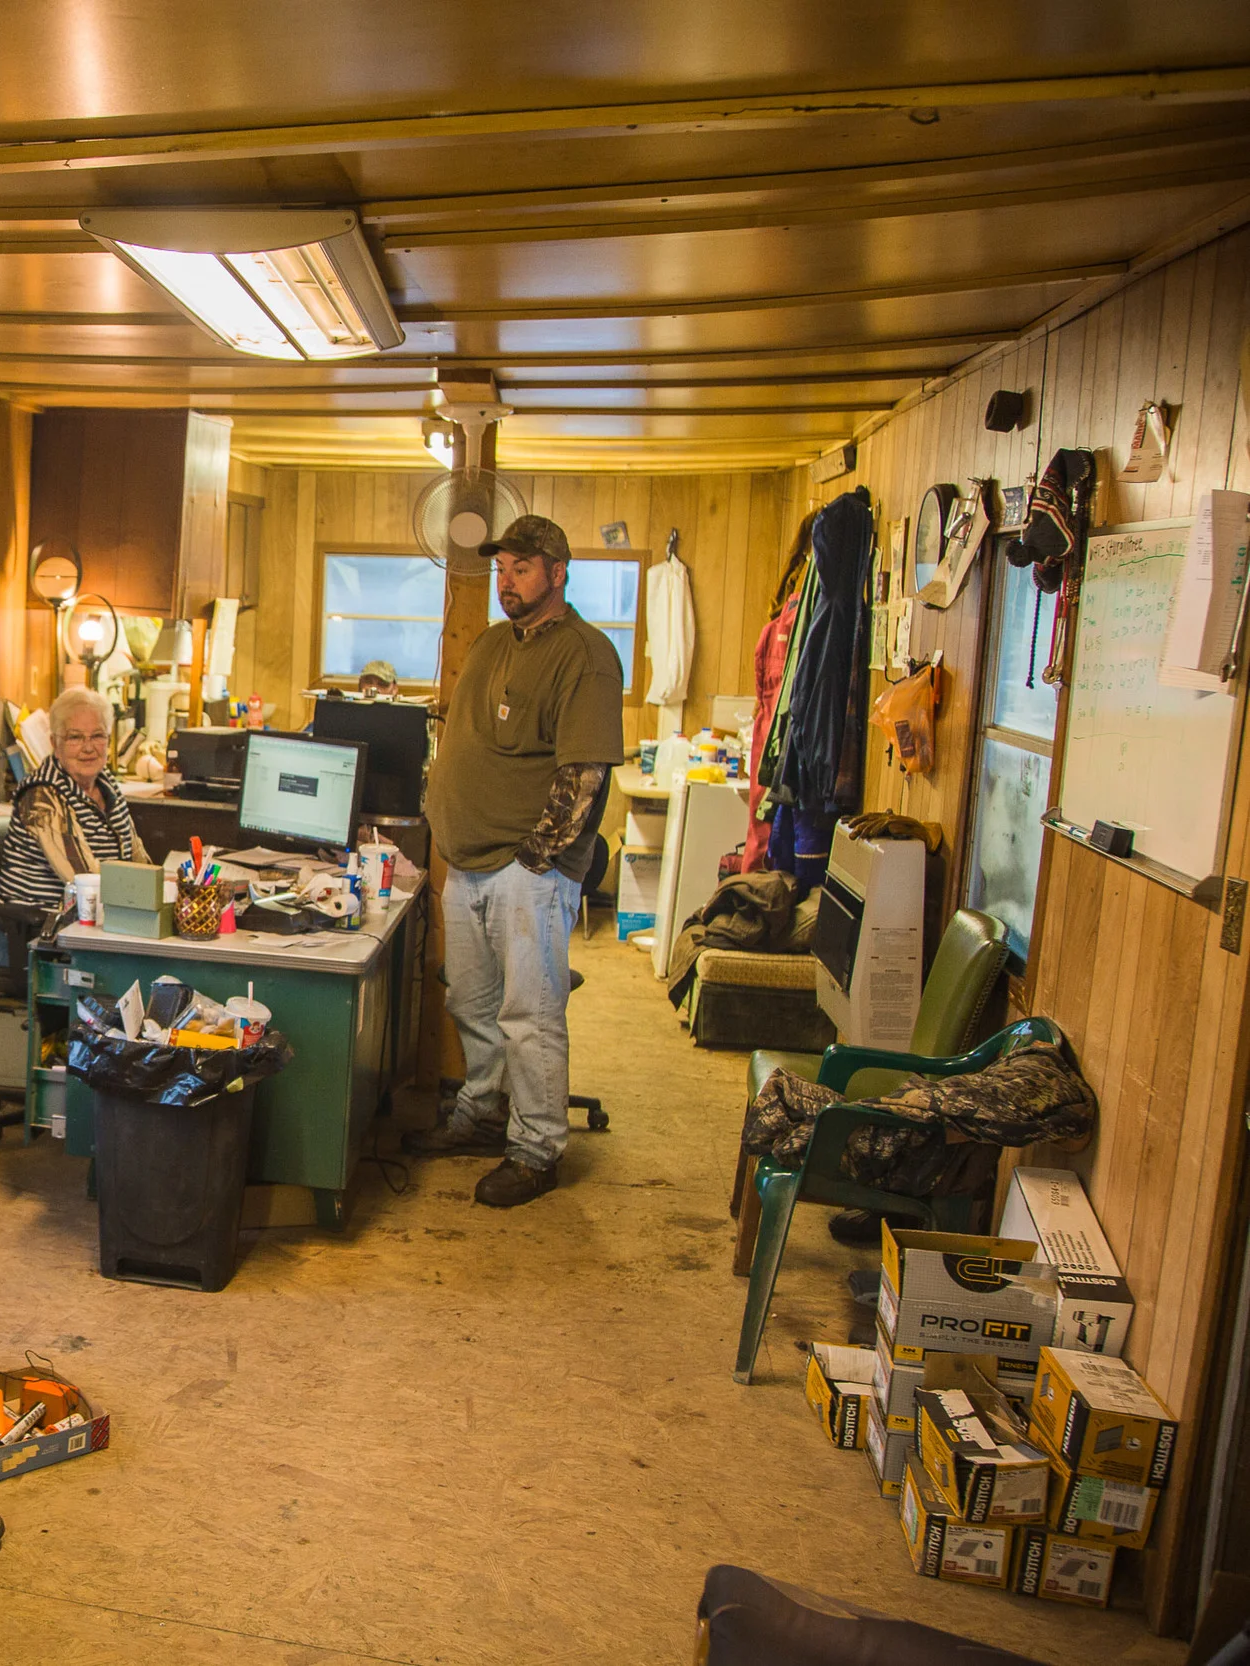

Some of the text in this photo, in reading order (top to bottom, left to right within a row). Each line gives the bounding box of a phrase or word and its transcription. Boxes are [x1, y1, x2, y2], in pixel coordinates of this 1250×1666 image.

[920, 1313, 1030, 1340] PROFIT
[961, 1336, 982, 1346] THE
[983, 1339, 1010, 1349] BEST
[1014, 1342, 1030, 1350] FIT
[999, 1360, 1035, 1371] TENERS
[843, 1403, 858, 1448] BOSTITCH
[1151, 1425, 1175, 1480] BOSTITCH
[971, 1476, 994, 1521] BOSTITCH
[925, 1525, 943, 1577] BOSTITCH
[1022, 1540, 1042, 1594] BOSTITCH
